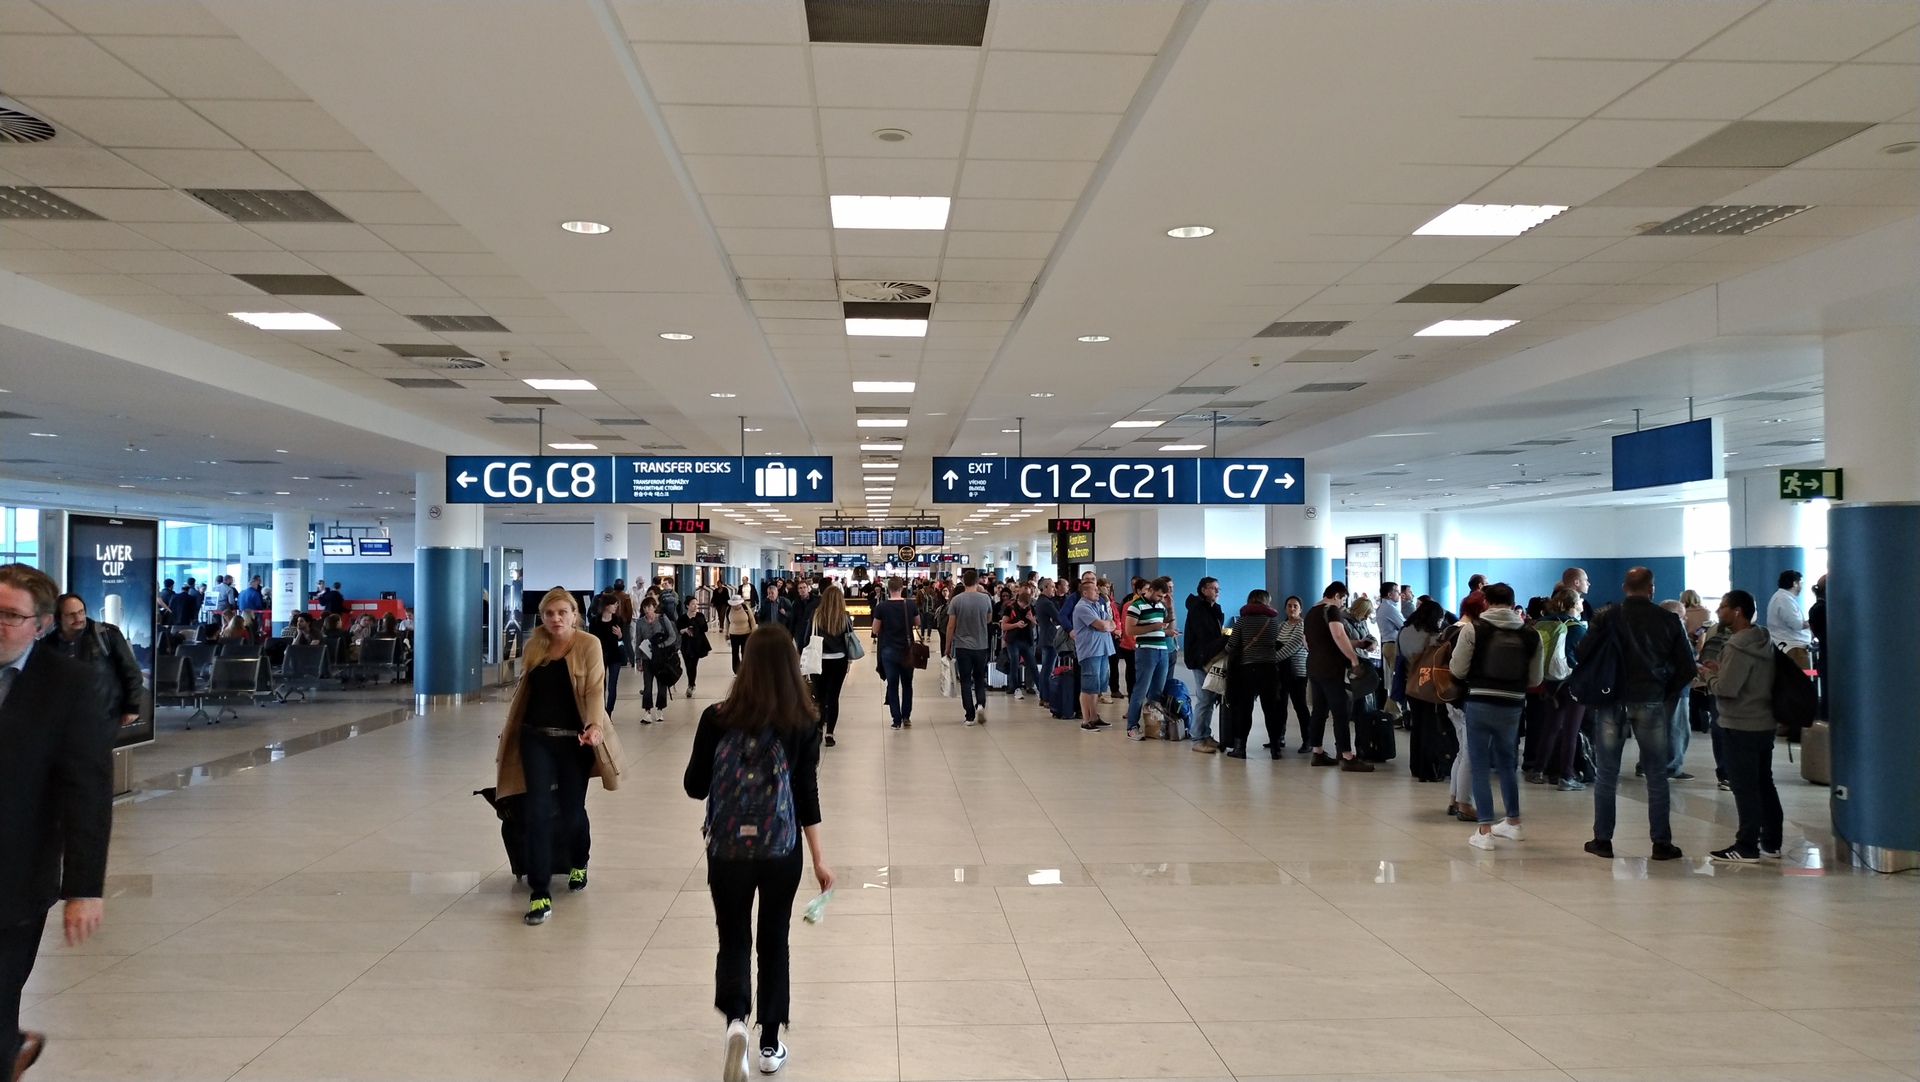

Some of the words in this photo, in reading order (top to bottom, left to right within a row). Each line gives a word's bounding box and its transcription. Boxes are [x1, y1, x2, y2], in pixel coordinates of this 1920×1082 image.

[632, 461, 693, 473] TRANSFER
[694, 461, 731, 473] DESKS
[968, 462, 994, 474] EXIT
[483, 461, 597, 504] C6,C8
[1019, 463, 1176, 499] C12-C21
[1222, 463, 1270, 499] C7
[669, 520, 705, 532] 17:04
[1056, 520, 1091, 531] 17:04
[96, 544, 133, 561] LAVER
